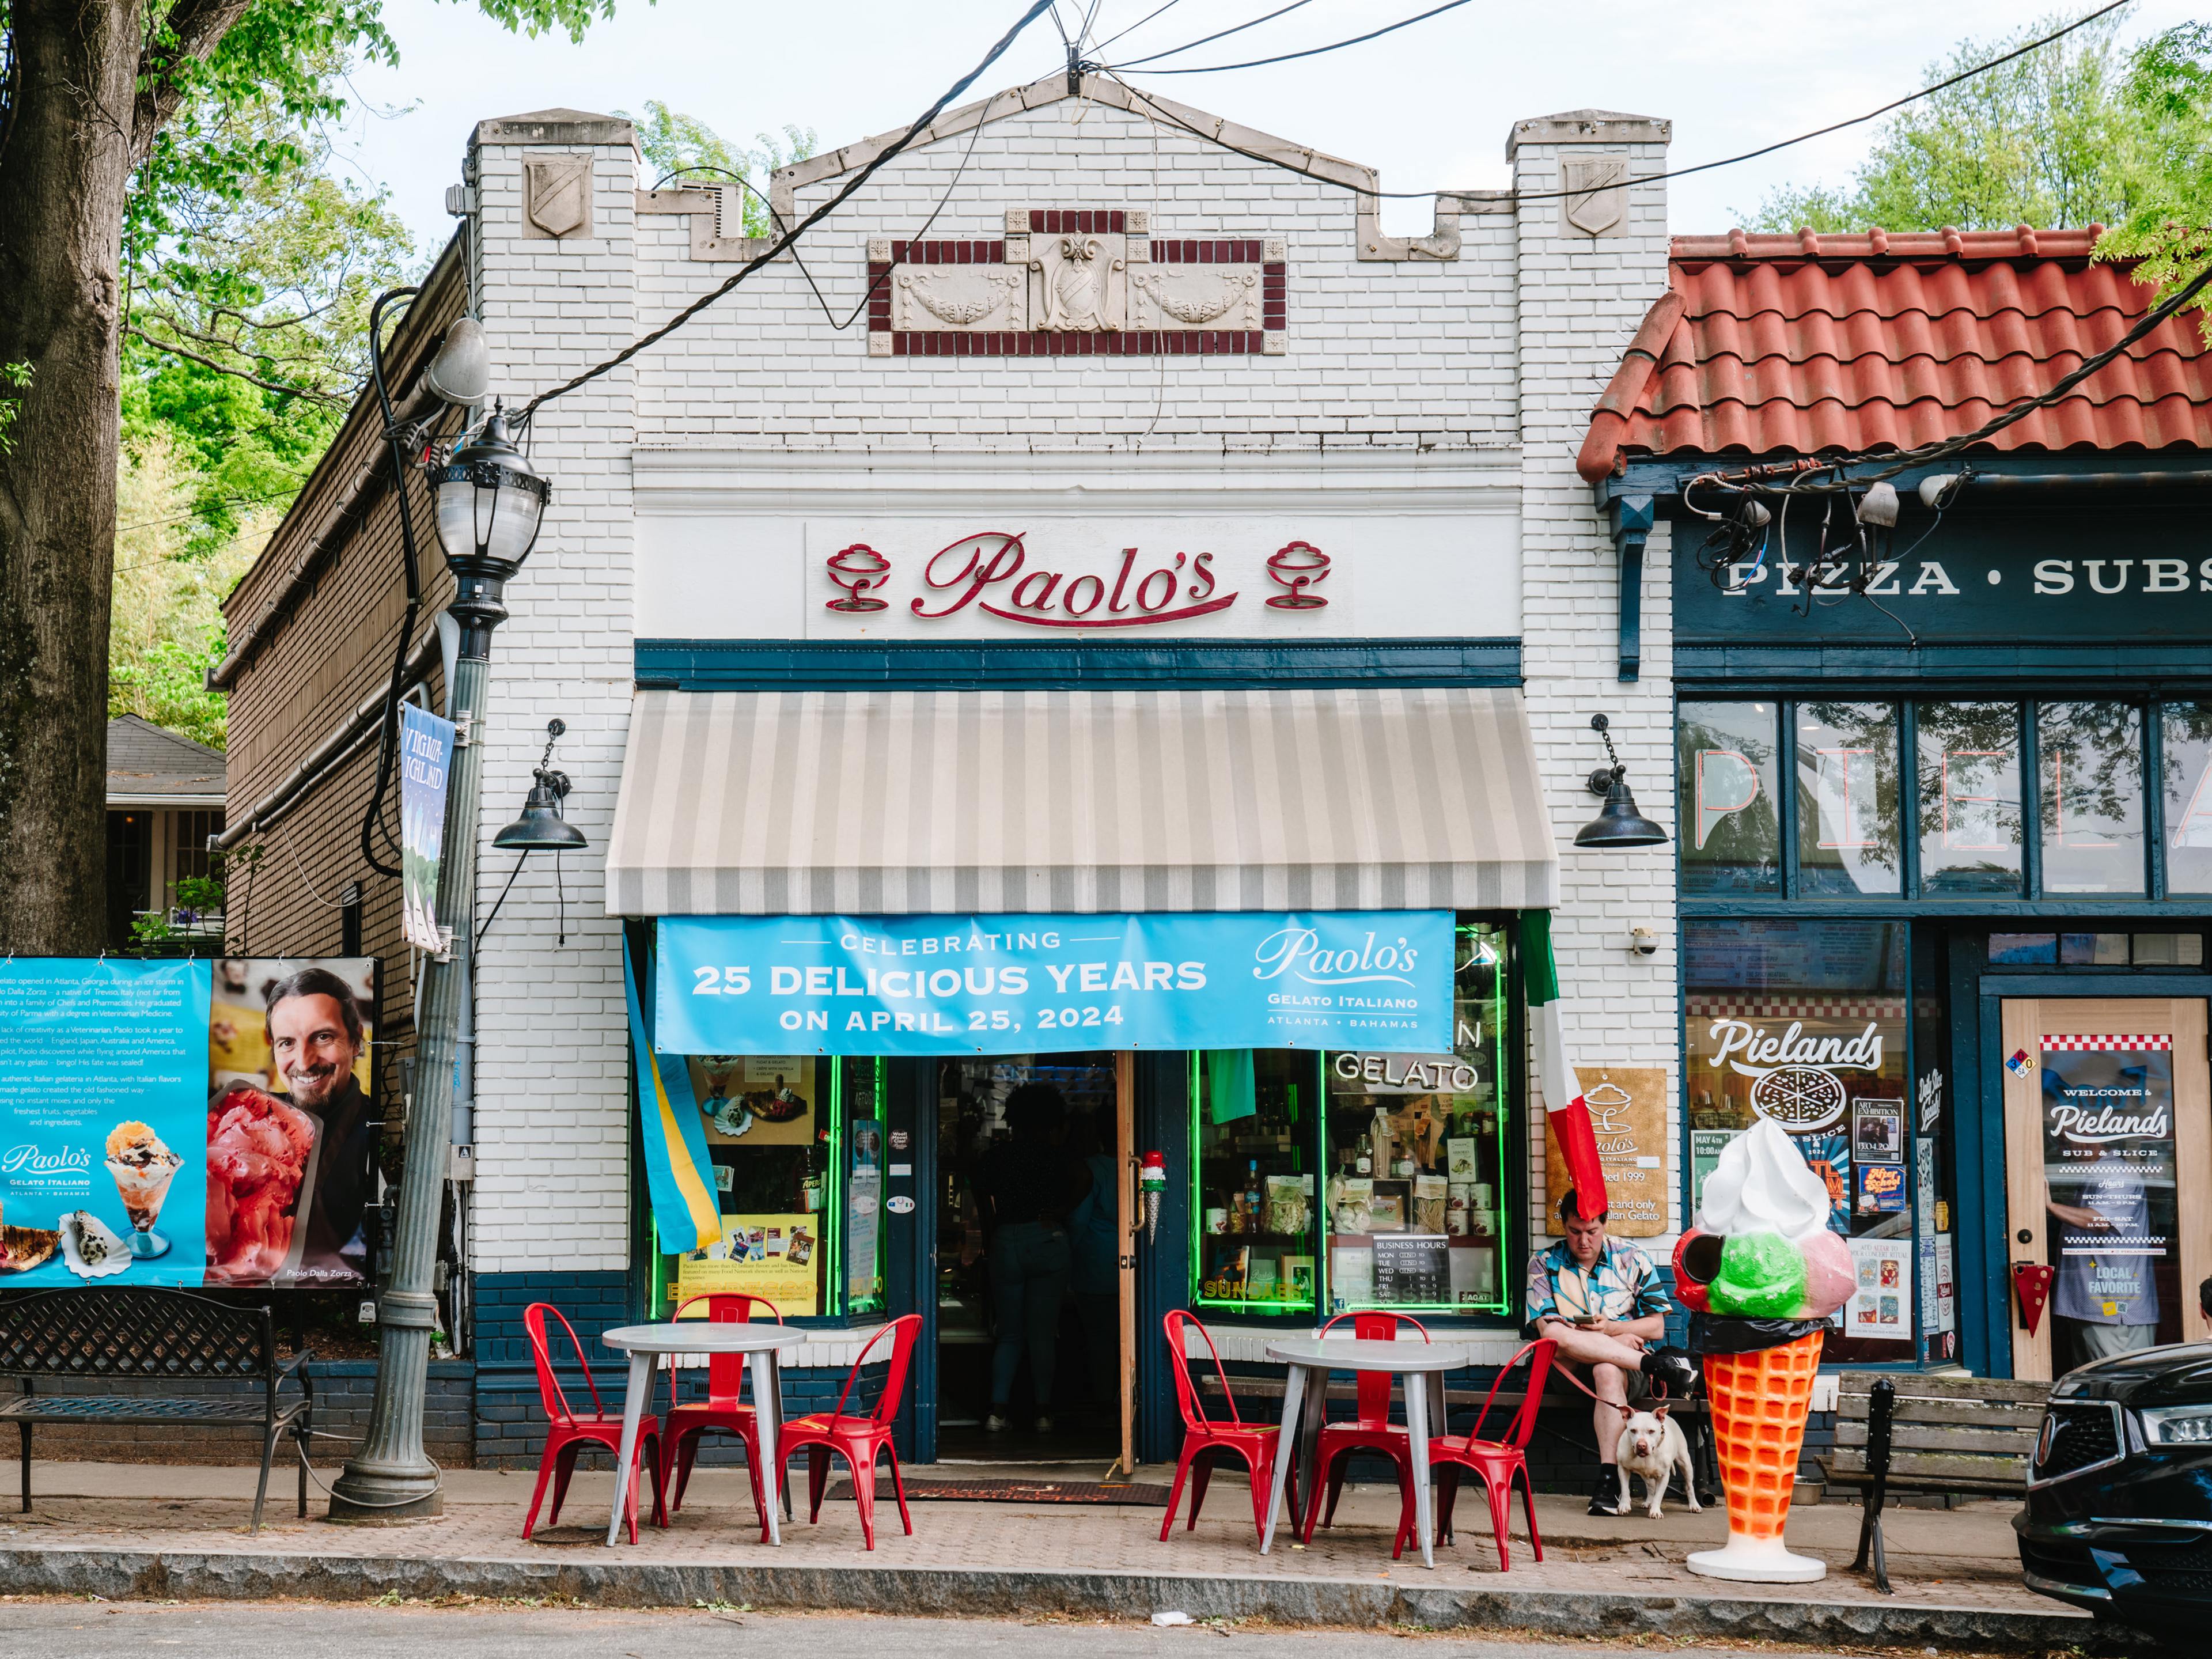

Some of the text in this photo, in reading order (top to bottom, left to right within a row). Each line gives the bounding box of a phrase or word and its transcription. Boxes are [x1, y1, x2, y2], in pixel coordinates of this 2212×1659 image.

[910, 531, 1239, 629] Paolo's
[1723, 562, 1960, 596] PIZZA
[840, 931, 1060, 956] CELEBRATING
[1252, 928, 1418, 988] Paolo's
[18, 978, 44, 986] opened
[82, 978, 108, 986] Georgia
[111, 978, 132, 987] during
[692, 961, 1207, 998] 25 DELICIOUS YEARS
[120, 989, 134, 998] Italy
[137, 989, 151, 997] (not
[26, 999, 46, 1007] family
[146, 999, 181, 1008] graduated
[1267, 993, 1418, 1009] GELATO ITALIANO
[66, 1010, 90, 1018] degree
[779, 1005, 1124, 1033] ON APRIL 25, 2024
[1267, 1016, 1418, 1029] ATLANTA BAHAMAS
[1709, 1021, 1883, 1073] Pielands
[2017, 1052, 2024, 1061] 0
[2010, 1059, 2032, 1069] 3 0
[1335, 1053, 1479, 1090] GELATO
[2050, 1105, 2168, 1143] Pielands
[1802, 1124, 1846, 1142] SLICE
[1696, 1136, 1722, 1144] MAY 4TH
[1, 1144, 91, 1175] Paolo's
[1623, 1172, 1645, 1181] 1999
[1868, 1167, 1898, 1180] After
[1865, 1175, 1900, 1187] School
[2098, 1179, 2124, 1189] Hours
[1616, 1199, 1656, 1211] and only
[1628, 1210, 1660, 1221] Gelato
[2096, 1267, 2132, 1279] LOCAL
[667, 1282, 818, 1301] ESPRESSO
[1205, 1281, 1302, 1302] SUNDAES
[2088, 1281, 2141, 1294] FAVORITE
